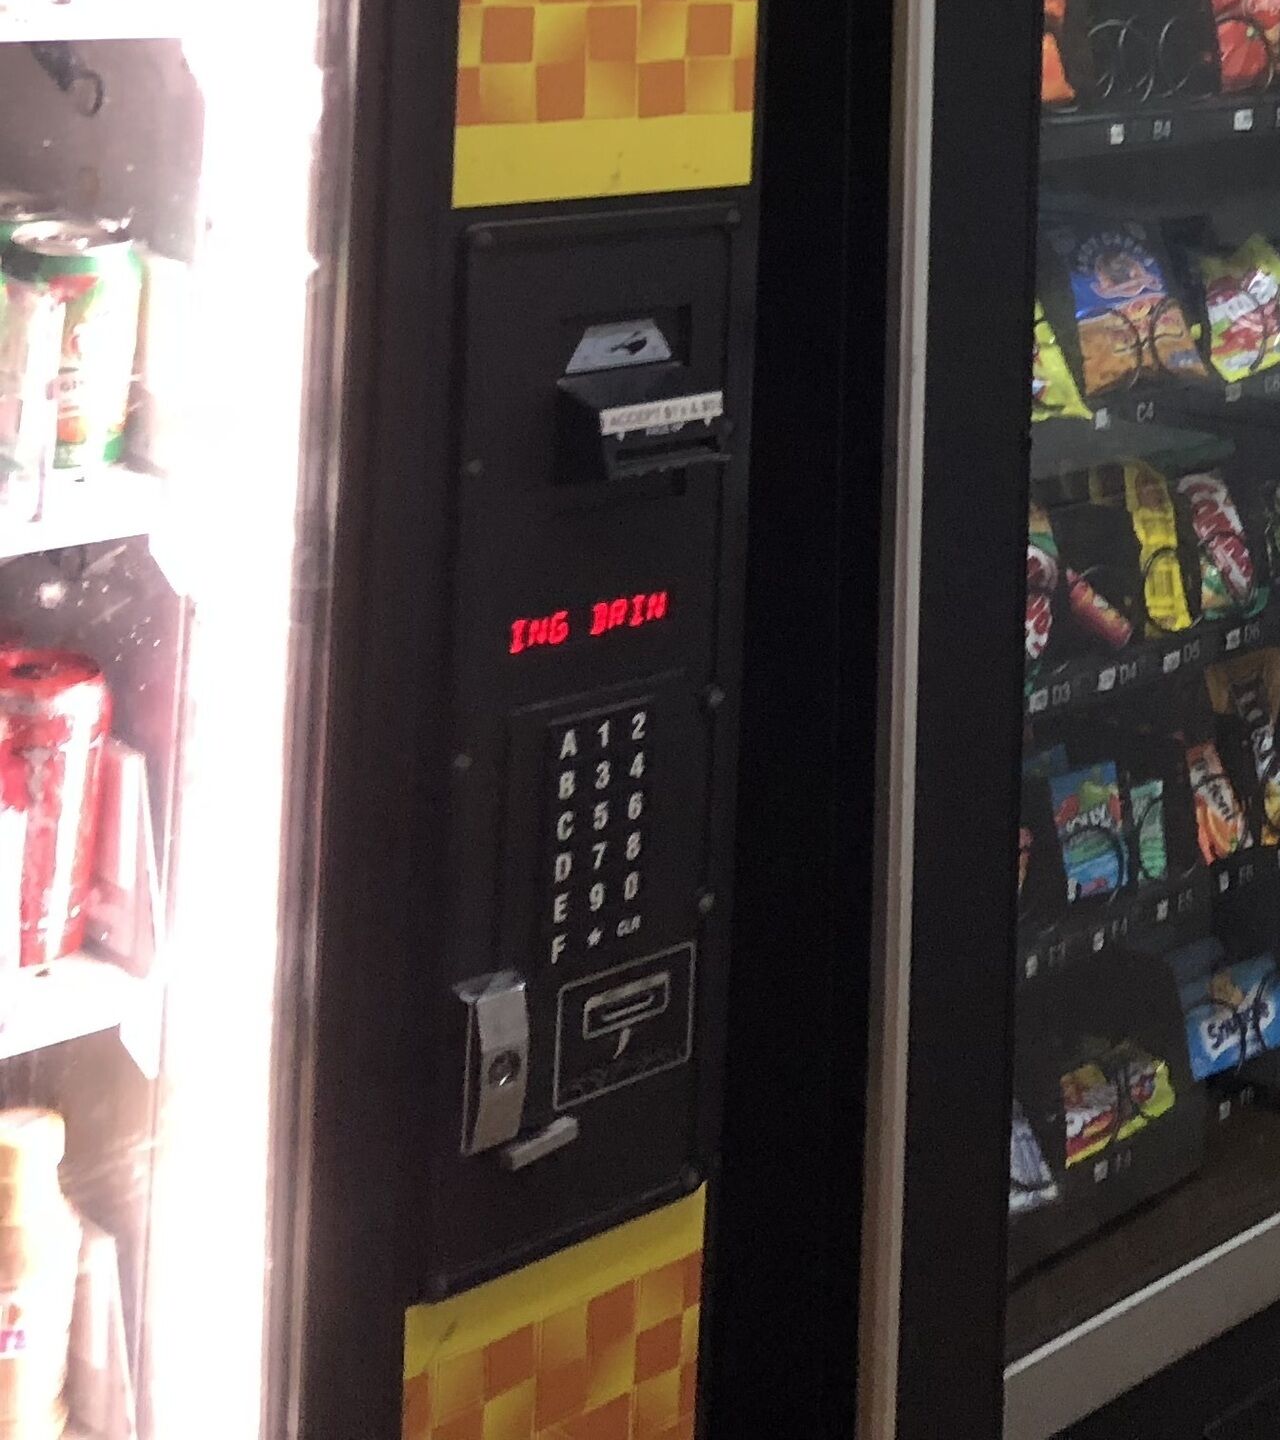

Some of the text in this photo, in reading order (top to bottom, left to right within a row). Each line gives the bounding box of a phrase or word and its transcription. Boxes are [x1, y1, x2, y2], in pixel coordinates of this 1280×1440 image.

[560, 711, 646, 760] A 1 2
[595, 760, 611, 789] 3
[556, 790, 643, 841] C 5 6
[555, 850, 573, 883] D
[592, 841, 608, 870] 7
[553, 892, 569, 924] E
[589, 882, 605, 911] 9
[551, 933, 567, 964] F
